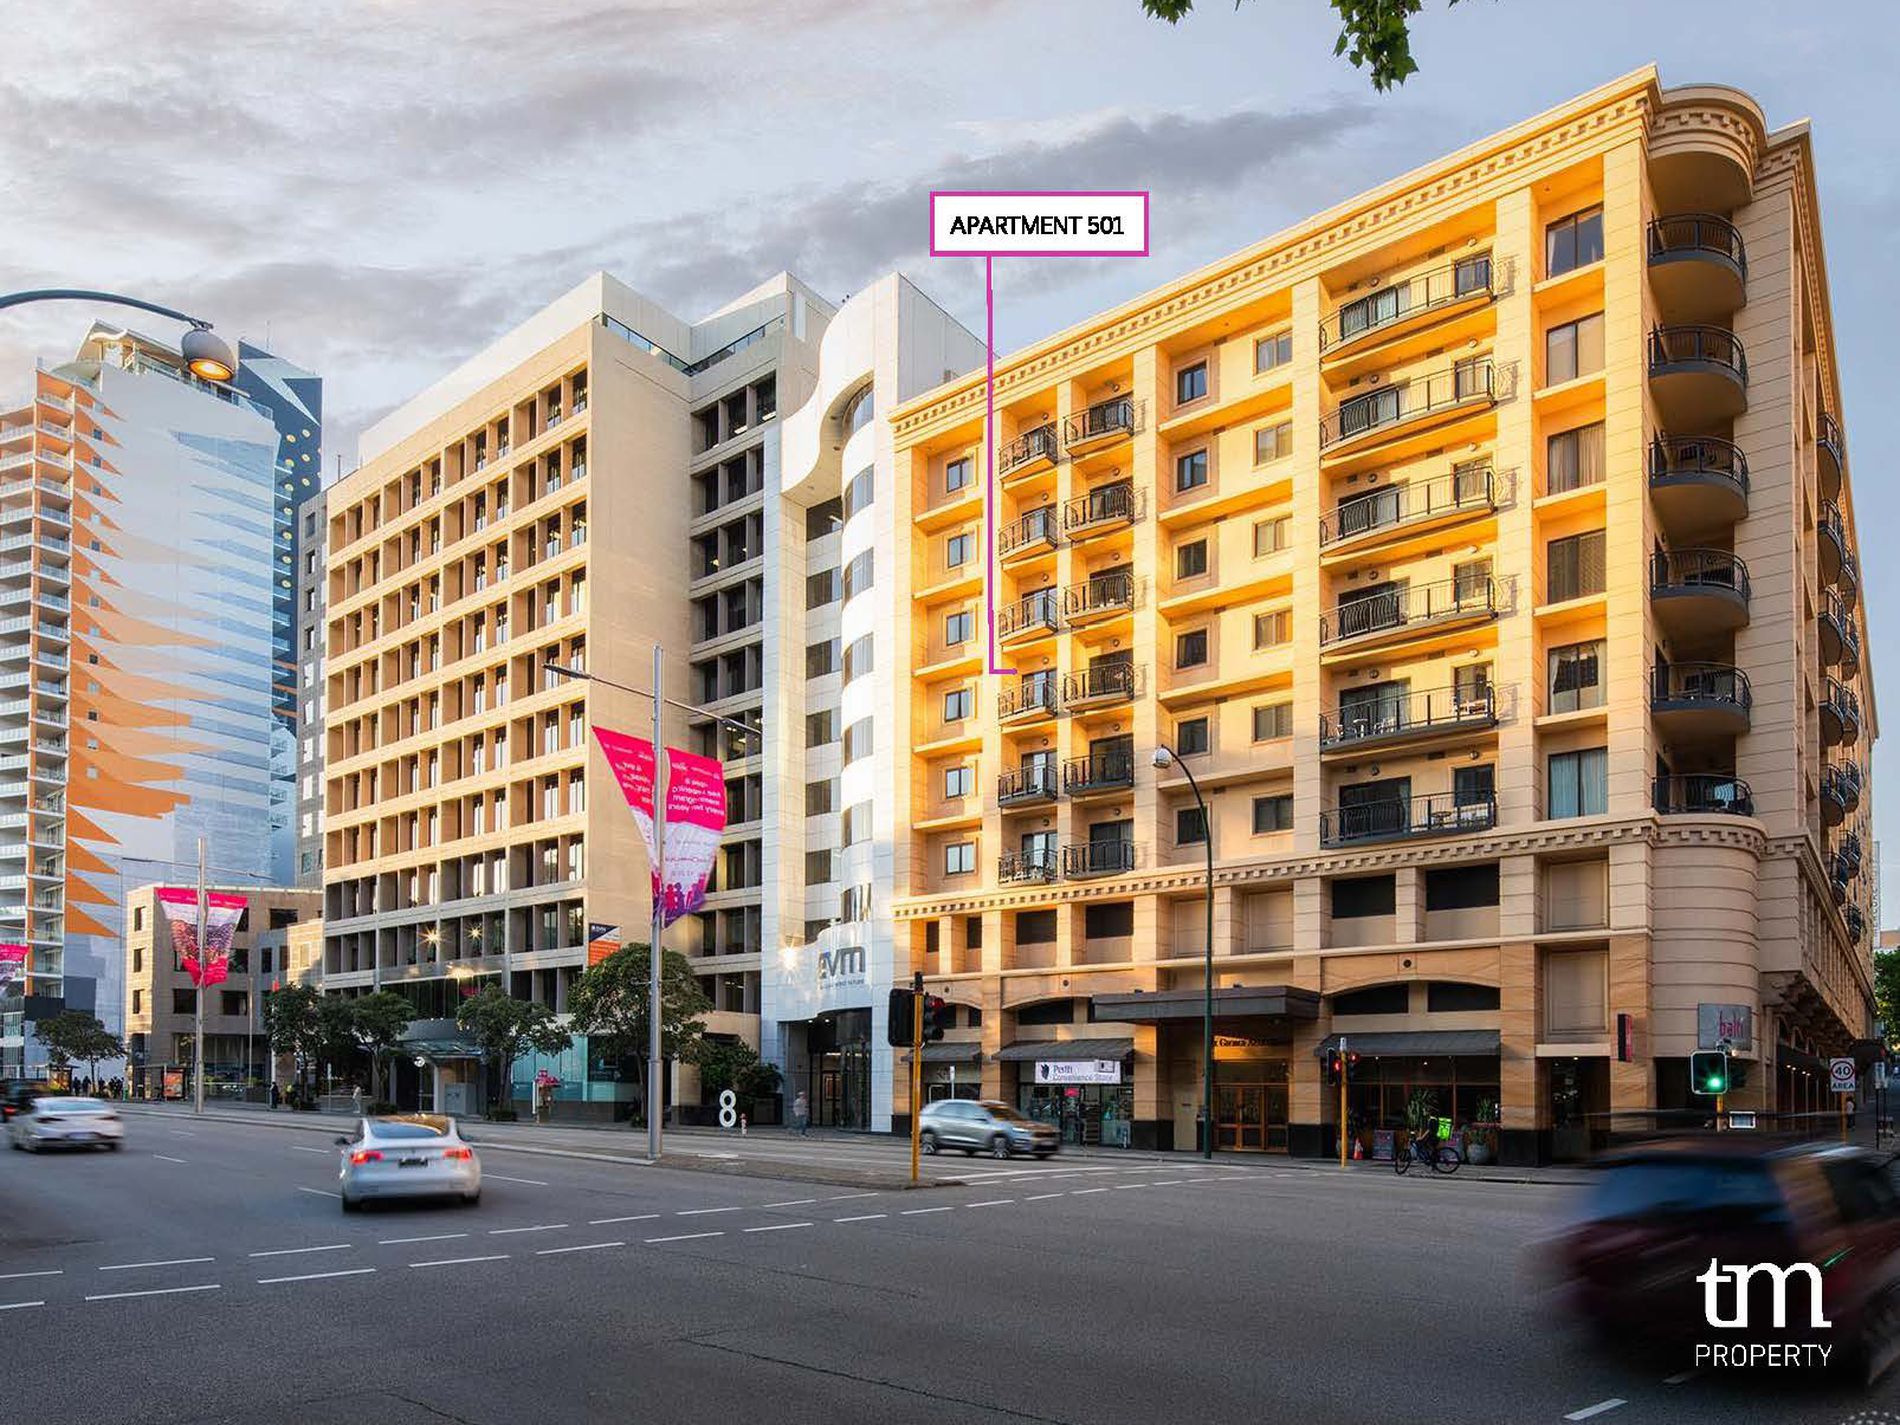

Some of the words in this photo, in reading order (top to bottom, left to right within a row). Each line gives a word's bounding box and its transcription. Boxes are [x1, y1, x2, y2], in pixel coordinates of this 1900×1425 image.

[1835, 1066, 1851, 1076] 40
[1832, 1082, 1854, 1090] AREA
[719, 1088, 737, 1128] 8
